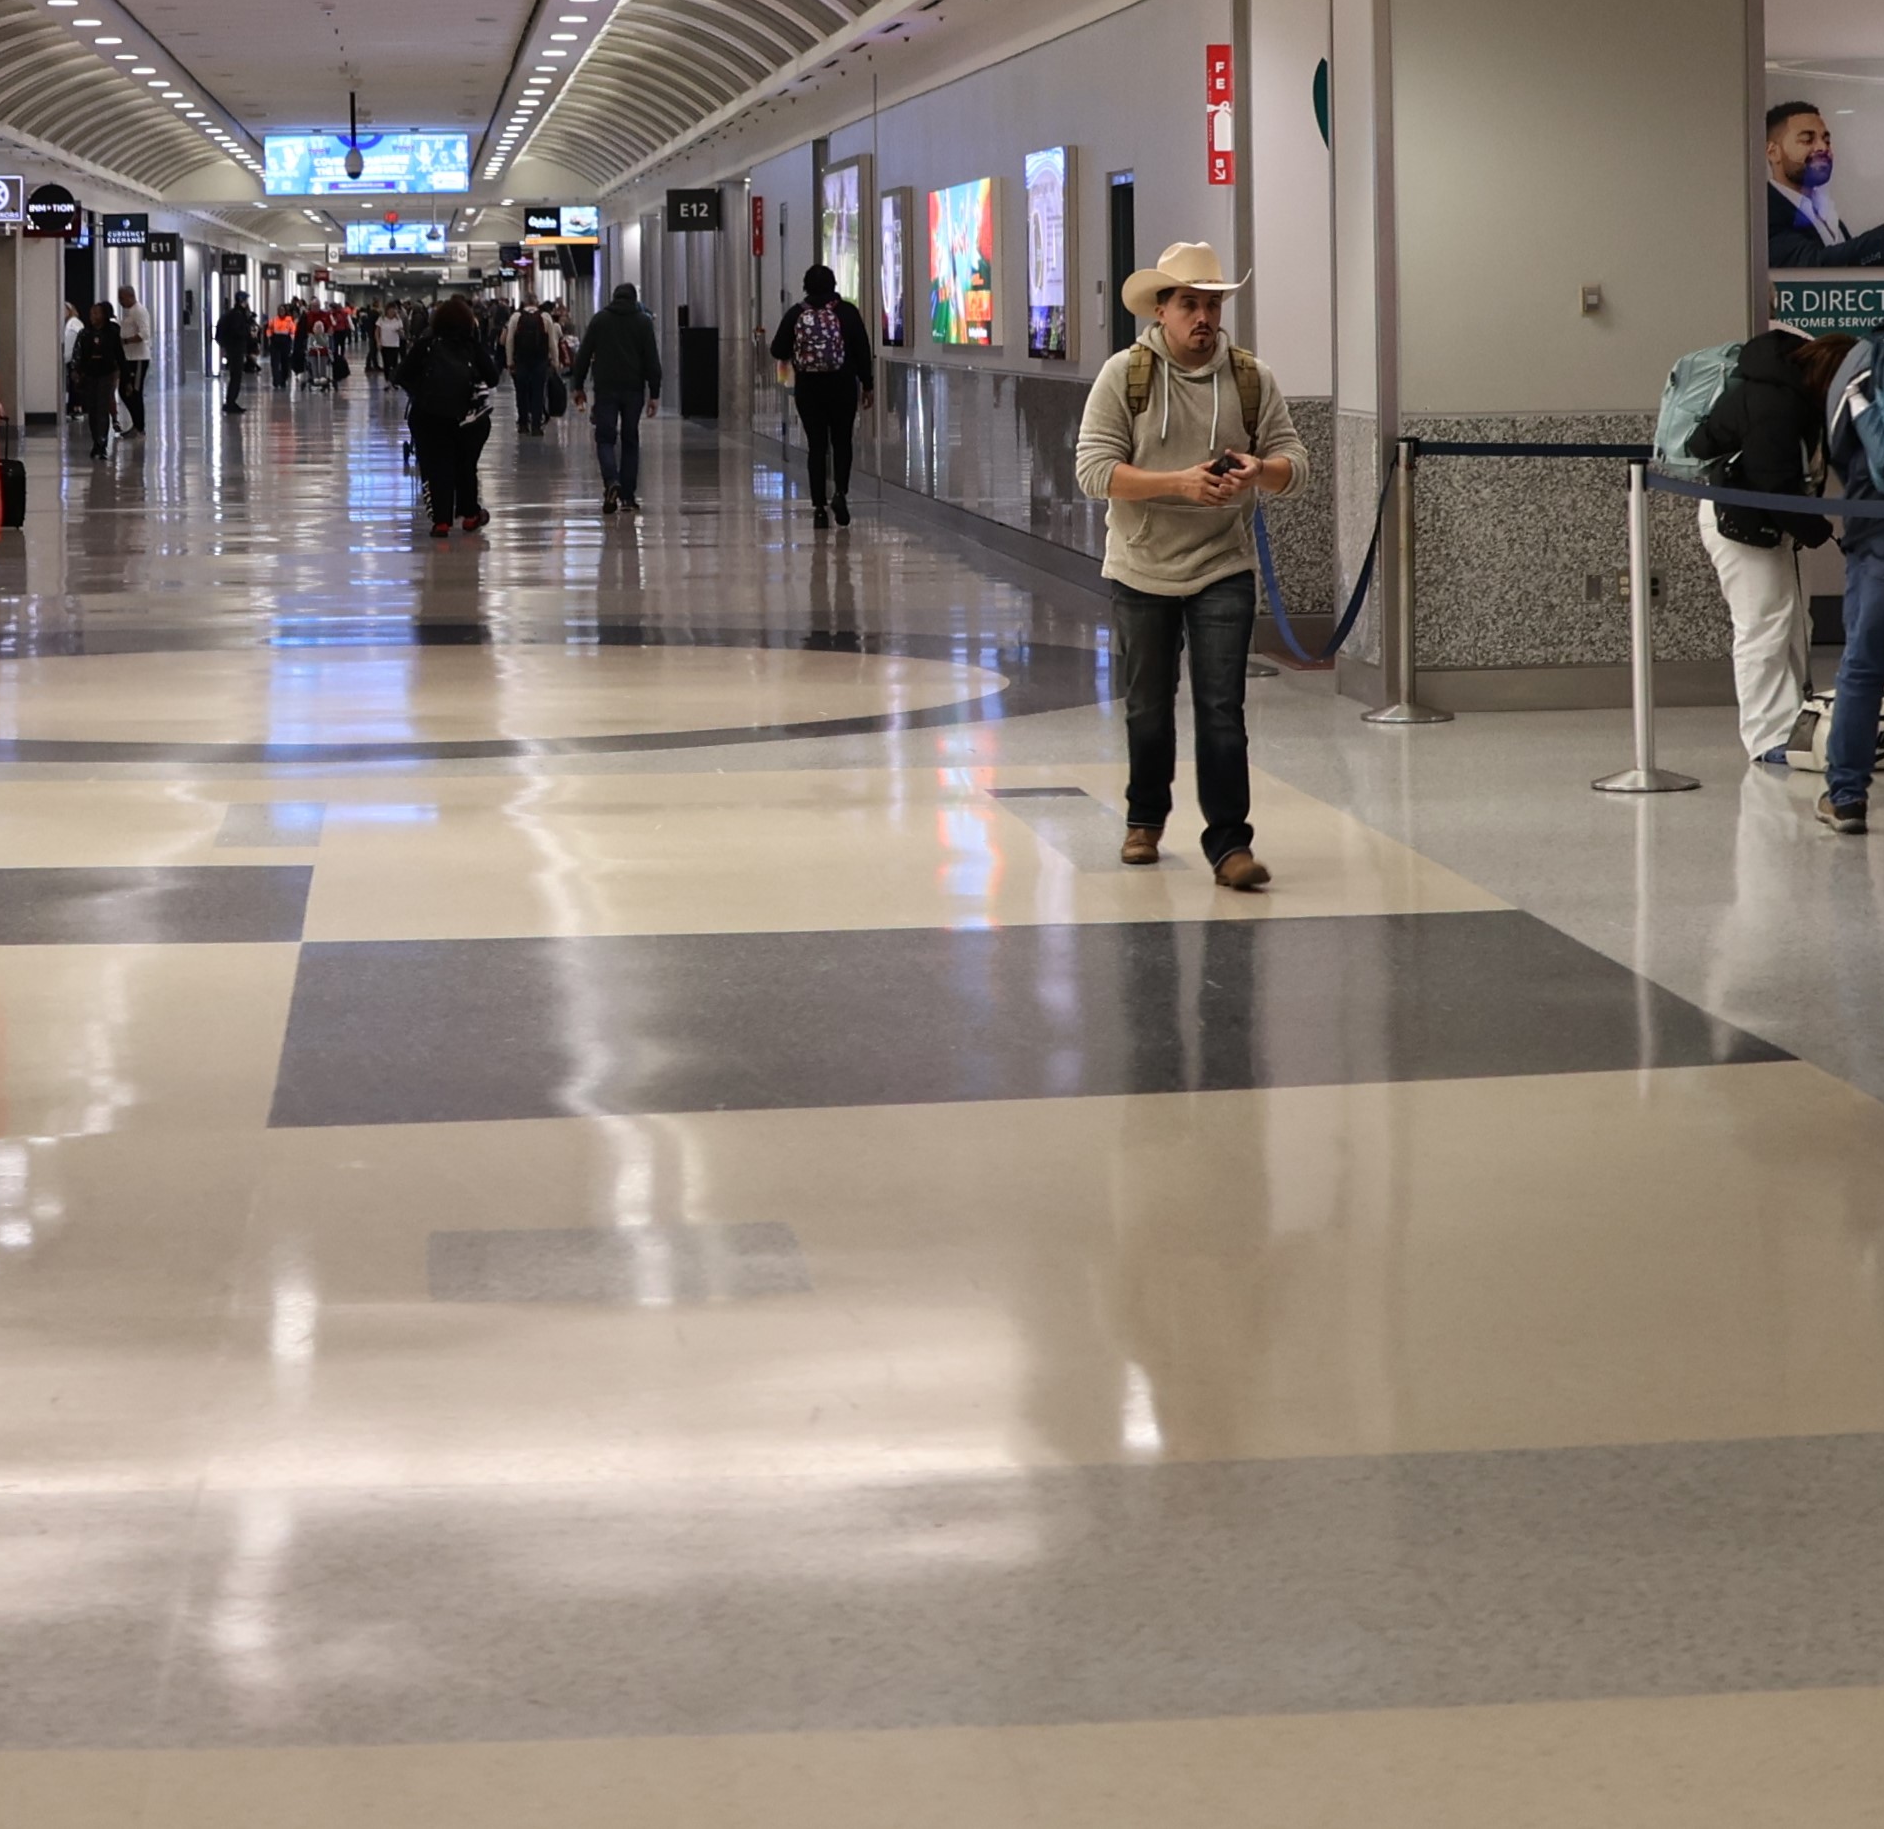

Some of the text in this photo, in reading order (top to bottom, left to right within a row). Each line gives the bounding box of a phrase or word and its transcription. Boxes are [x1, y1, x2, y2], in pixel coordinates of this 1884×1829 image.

[680, 203, 709, 217] E12
[151, 242, 170, 253] E11
[1774, 290, 1795, 312] R
